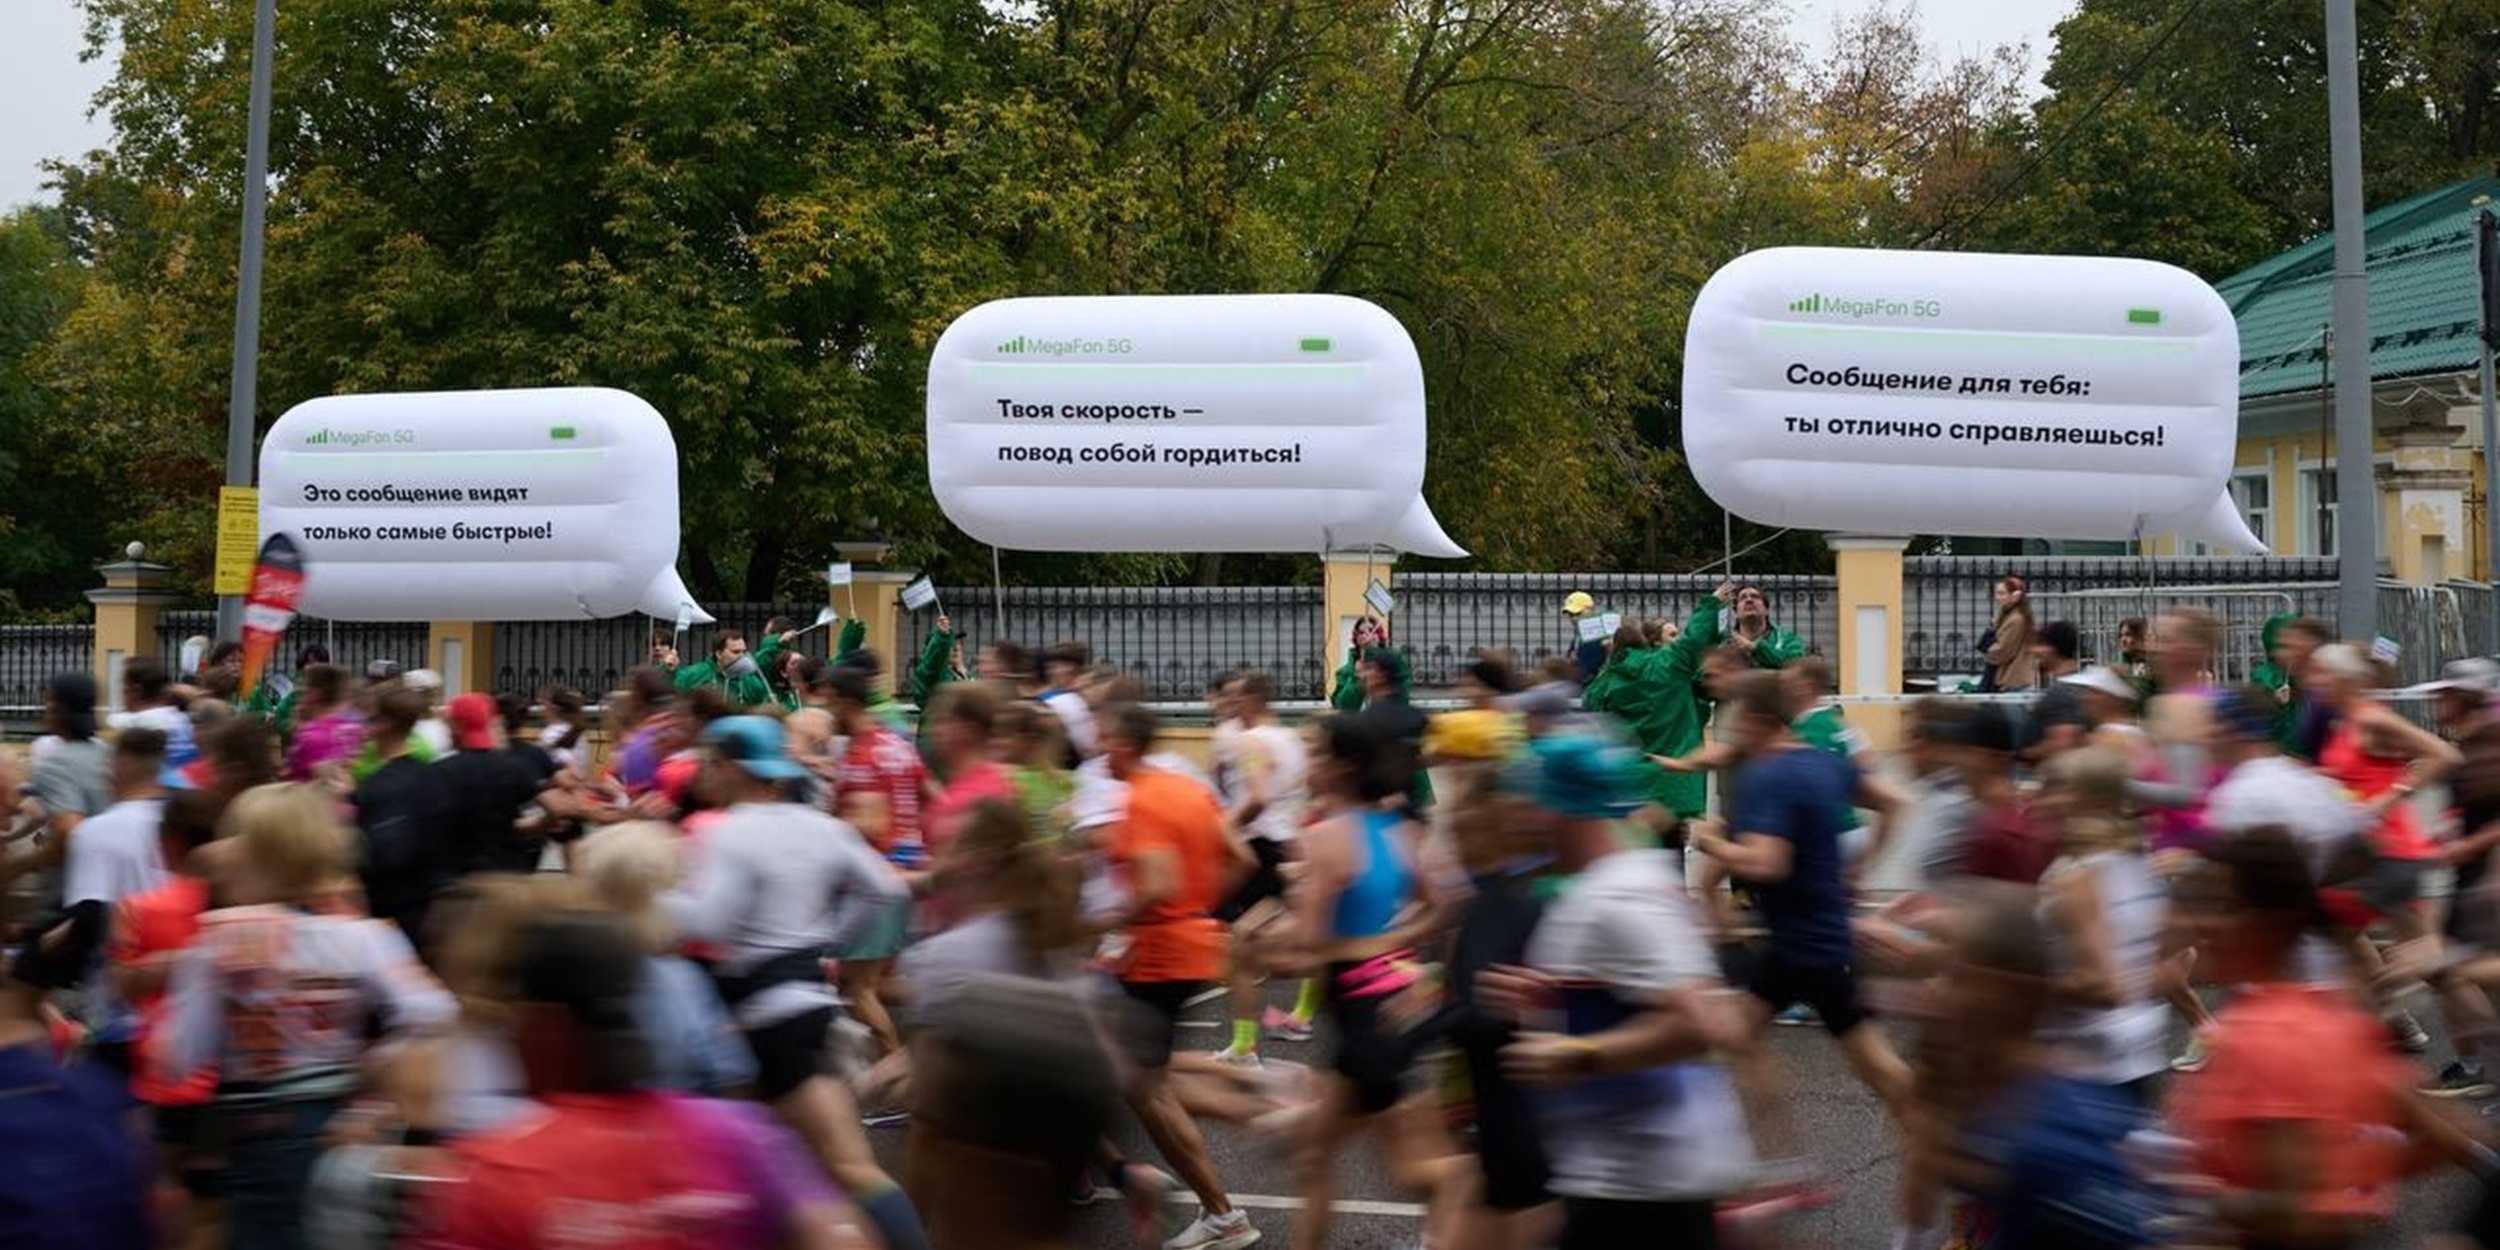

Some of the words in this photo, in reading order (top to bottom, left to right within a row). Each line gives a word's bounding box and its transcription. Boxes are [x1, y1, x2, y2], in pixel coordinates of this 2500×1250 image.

[1823, 297, 1909, 318] MegaFon
[1912, 299, 1941, 317] 5G
[1027, 338, 1103, 356] MegaFon
[1107, 338, 1133, 354] 5G
[1786, 362, 1953, 391] Сообщение
[1957, 376, 2012, 395] для
[2019, 374, 2091, 396] тебя:
[996, 398, 1055, 419] Твоя
[1060, 404, 1176, 424] скорость
[329, 429, 390, 447] MegaFon
[393, 428, 415, 445] 5G
[1785, 416, 1820, 434] ты
[1827, 418, 1942, 439] отлично
[1949, 423, 2165, 447] справляешься!
[998, 446, 1074, 465] повод
[1079, 442, 1156, 464] собой
[1163, 442, 1301, 468] гордиться!
[303, 483, 342, 502] Это
[345, 484, 464, 504] сообщение
[467, 486, 529, 504] видят
[303, 525, 372, 541] только
[376, 525, 447, 540] самые
[452, 521, 552, 544] быстрые!
